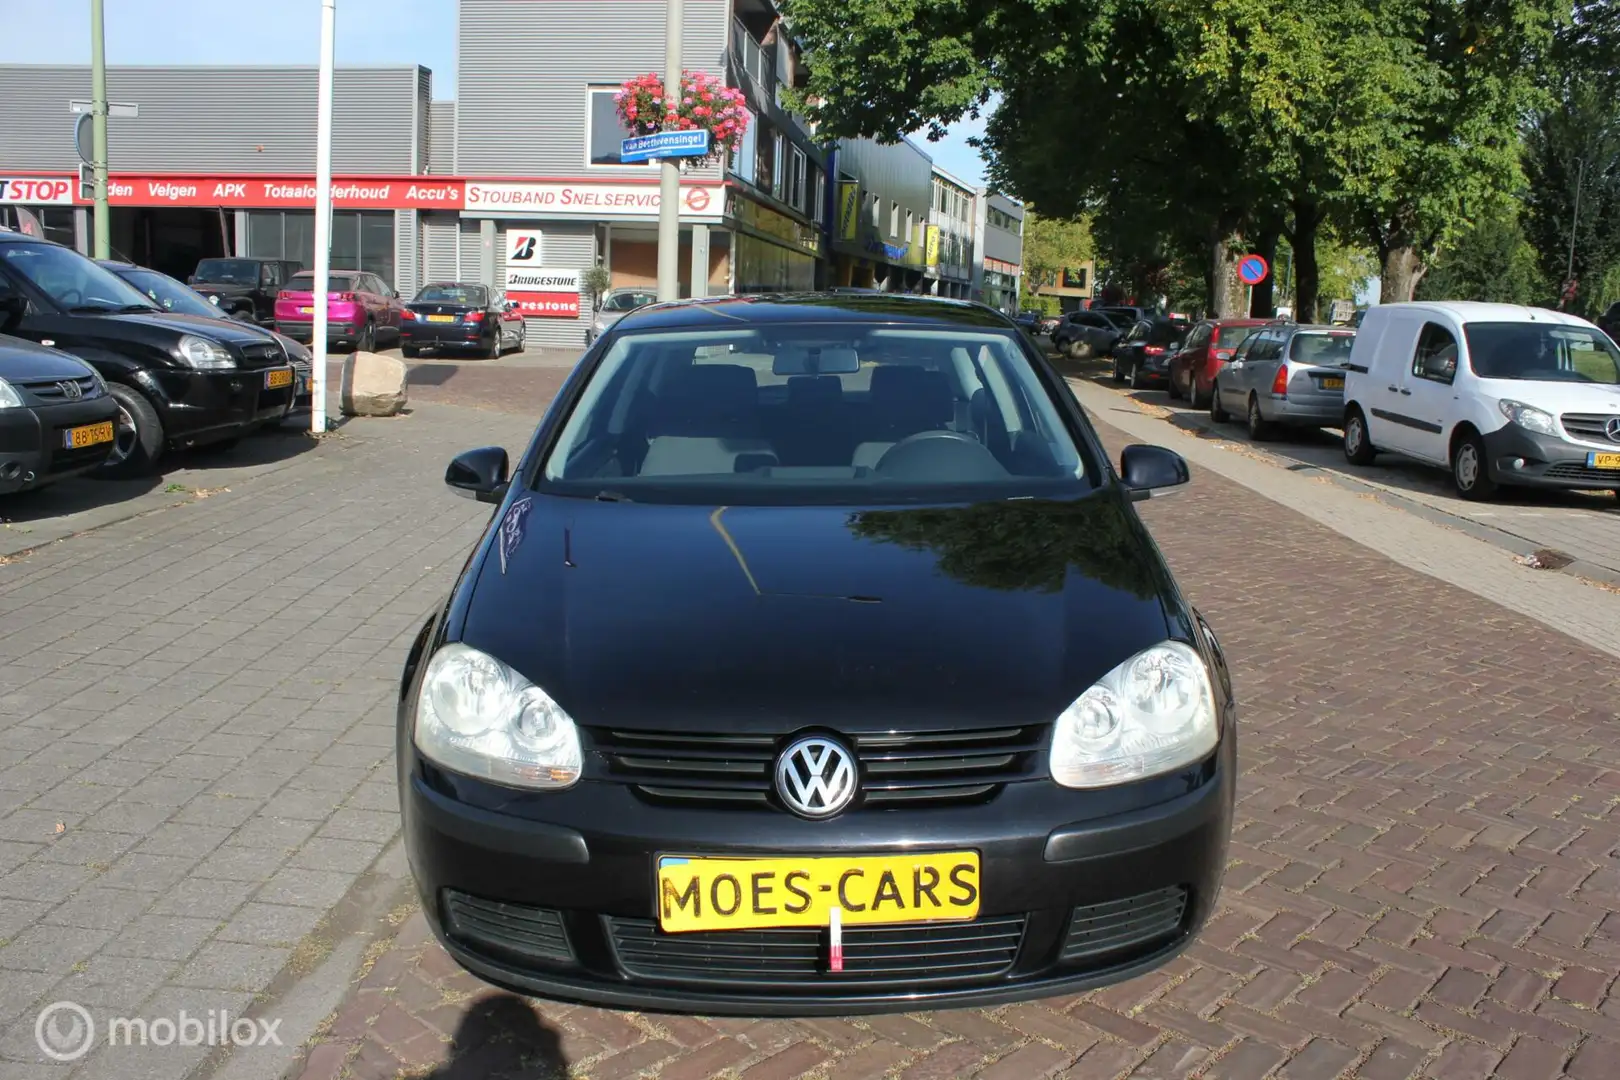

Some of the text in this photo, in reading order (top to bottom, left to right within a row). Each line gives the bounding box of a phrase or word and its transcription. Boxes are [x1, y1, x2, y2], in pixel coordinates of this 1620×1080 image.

[149, 182, 196, 200] Velgen
[213, 183, 246, 198] APK
[264, 184, 390, 199] Totaaloderhoud
[405, 185, 459, 200] Accu's
[468, 186, 662, 207] STOUBAND SNELSERVIC
[508, 274, 577, 286] BRIDGESTONE
[507, 300, 577, 311] restone
[662, 863, 978, 919] MOES-CARS
